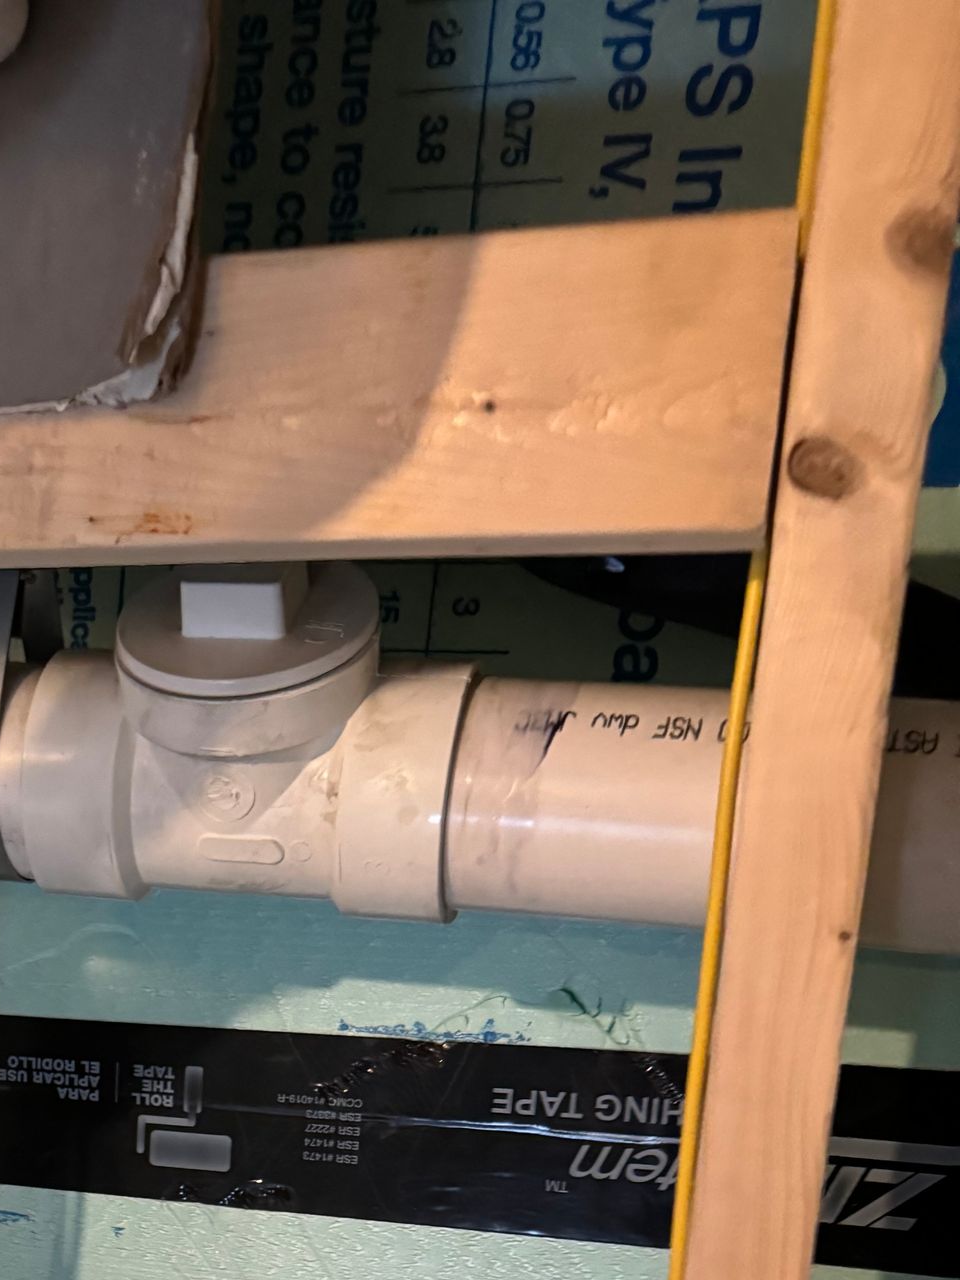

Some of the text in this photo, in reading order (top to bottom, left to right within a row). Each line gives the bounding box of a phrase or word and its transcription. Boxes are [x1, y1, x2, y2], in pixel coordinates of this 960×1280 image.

[685, 0, 763, 117] PS
[416, 20, 463, 165] 2.8 3.8
[500, 2, 546, 168] 0.56 0.75
[222, 14, 274, 184] shape,
[280, 123, 321, 174] to
[590, 133, 653, 198] IV,
[653, 716, 702, 742] NSF
[6, 1056, 176, 1079] TAPE EL RODILLO
[32, 1071, 101, 1088] APLICAR
[57, 1086, 175, 1108] ROLL PARA
[143, 1078, 176, 1093] THE
[492, 1087, 585, 1120] TAPE
[339, 1110, 363, 1123] ESR
[305, 1122, 362, 1137] ESR #2227
[303, 1136, 361, 1151] ESR #1474
[302, 1150, 359, 1166] ESR #1473
[546, 1179, 570, 1194] TM
[820, 1164, 948, 1232] ZI
